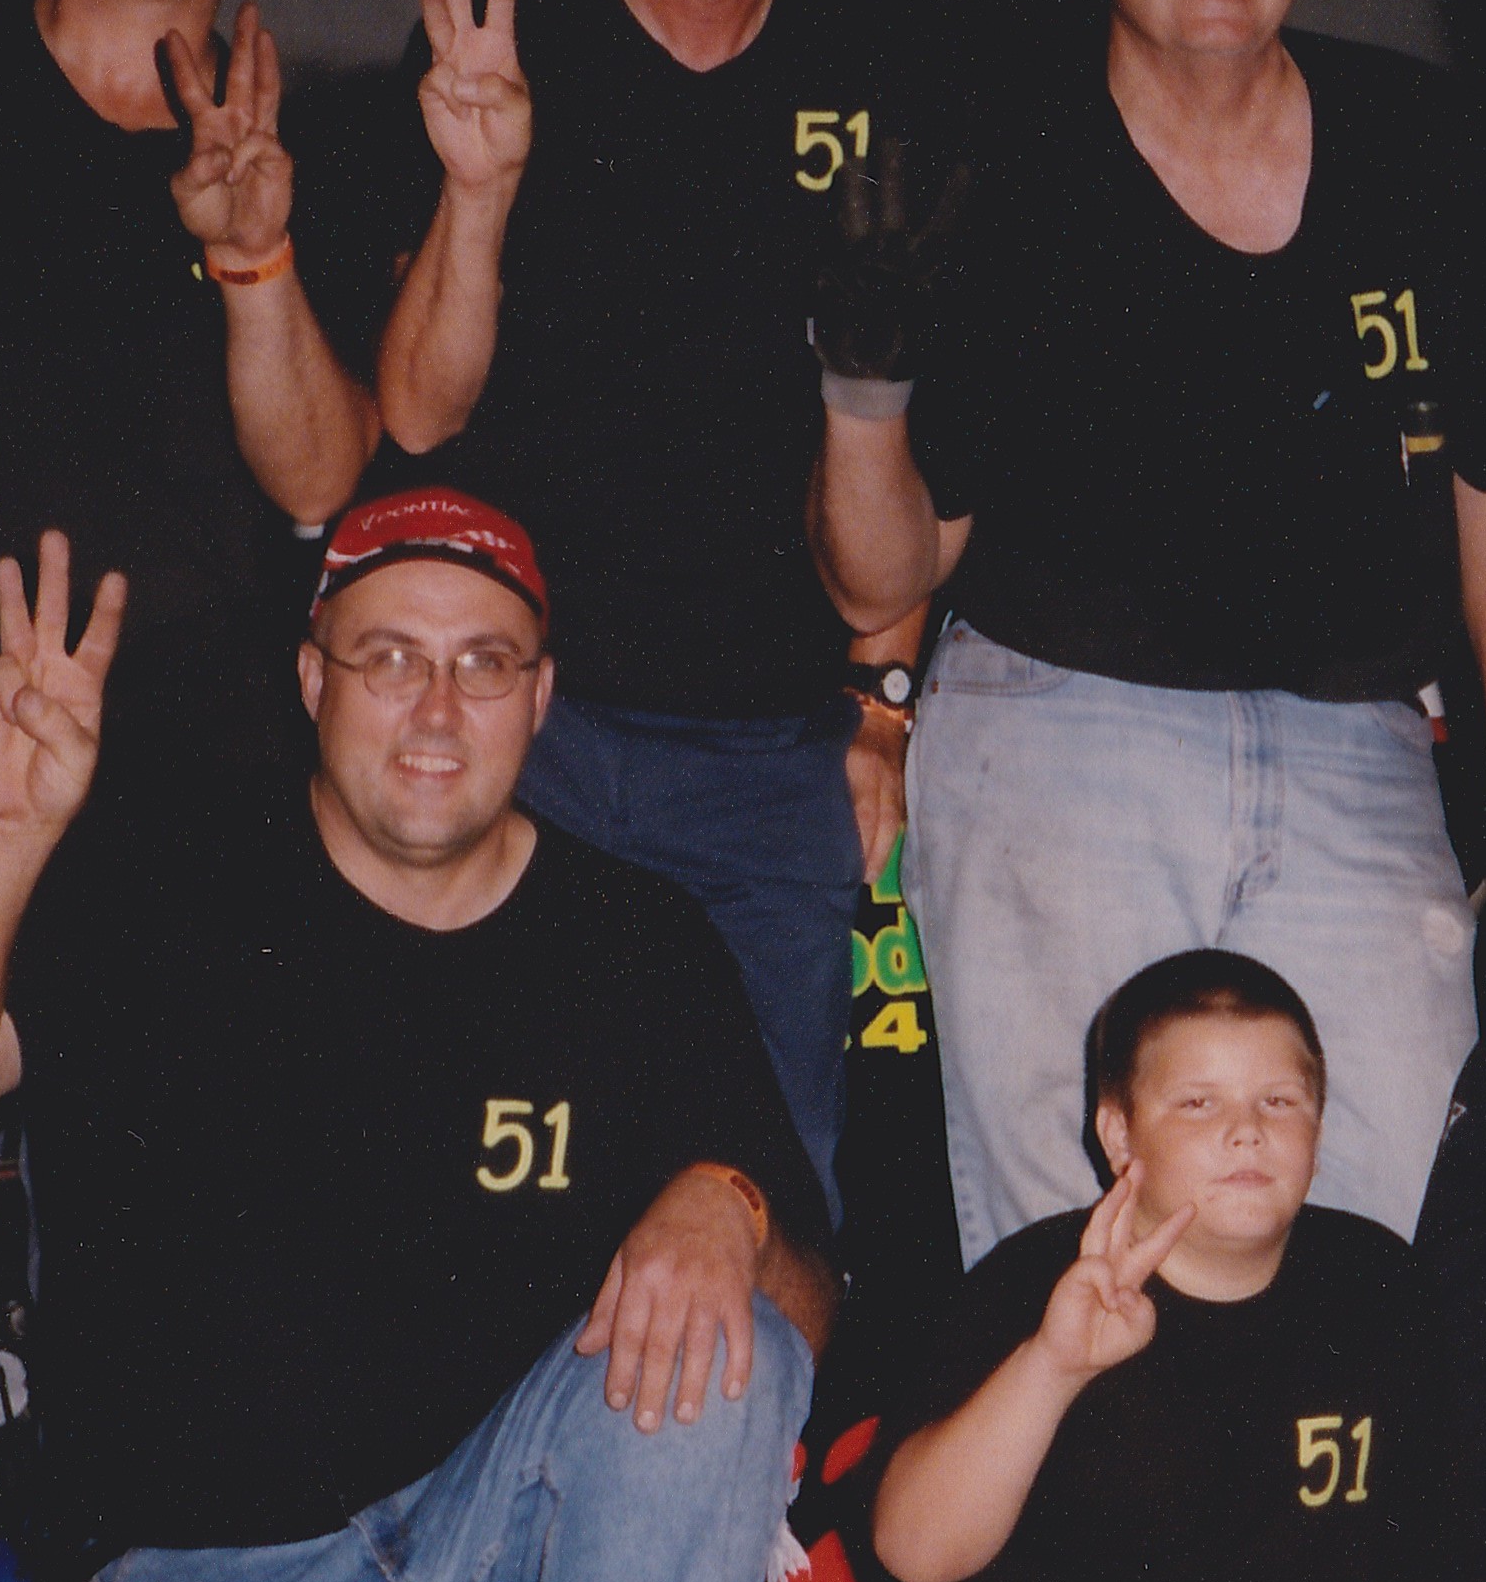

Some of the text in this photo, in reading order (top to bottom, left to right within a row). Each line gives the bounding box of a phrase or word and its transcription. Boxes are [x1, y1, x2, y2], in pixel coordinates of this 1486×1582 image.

[795, 110, 870, 192] 51
[1350, 289, 1428, 380] 51
[476, 1099, 570, 1192] 51
[1296, 1415, 1372, 1508] 51
